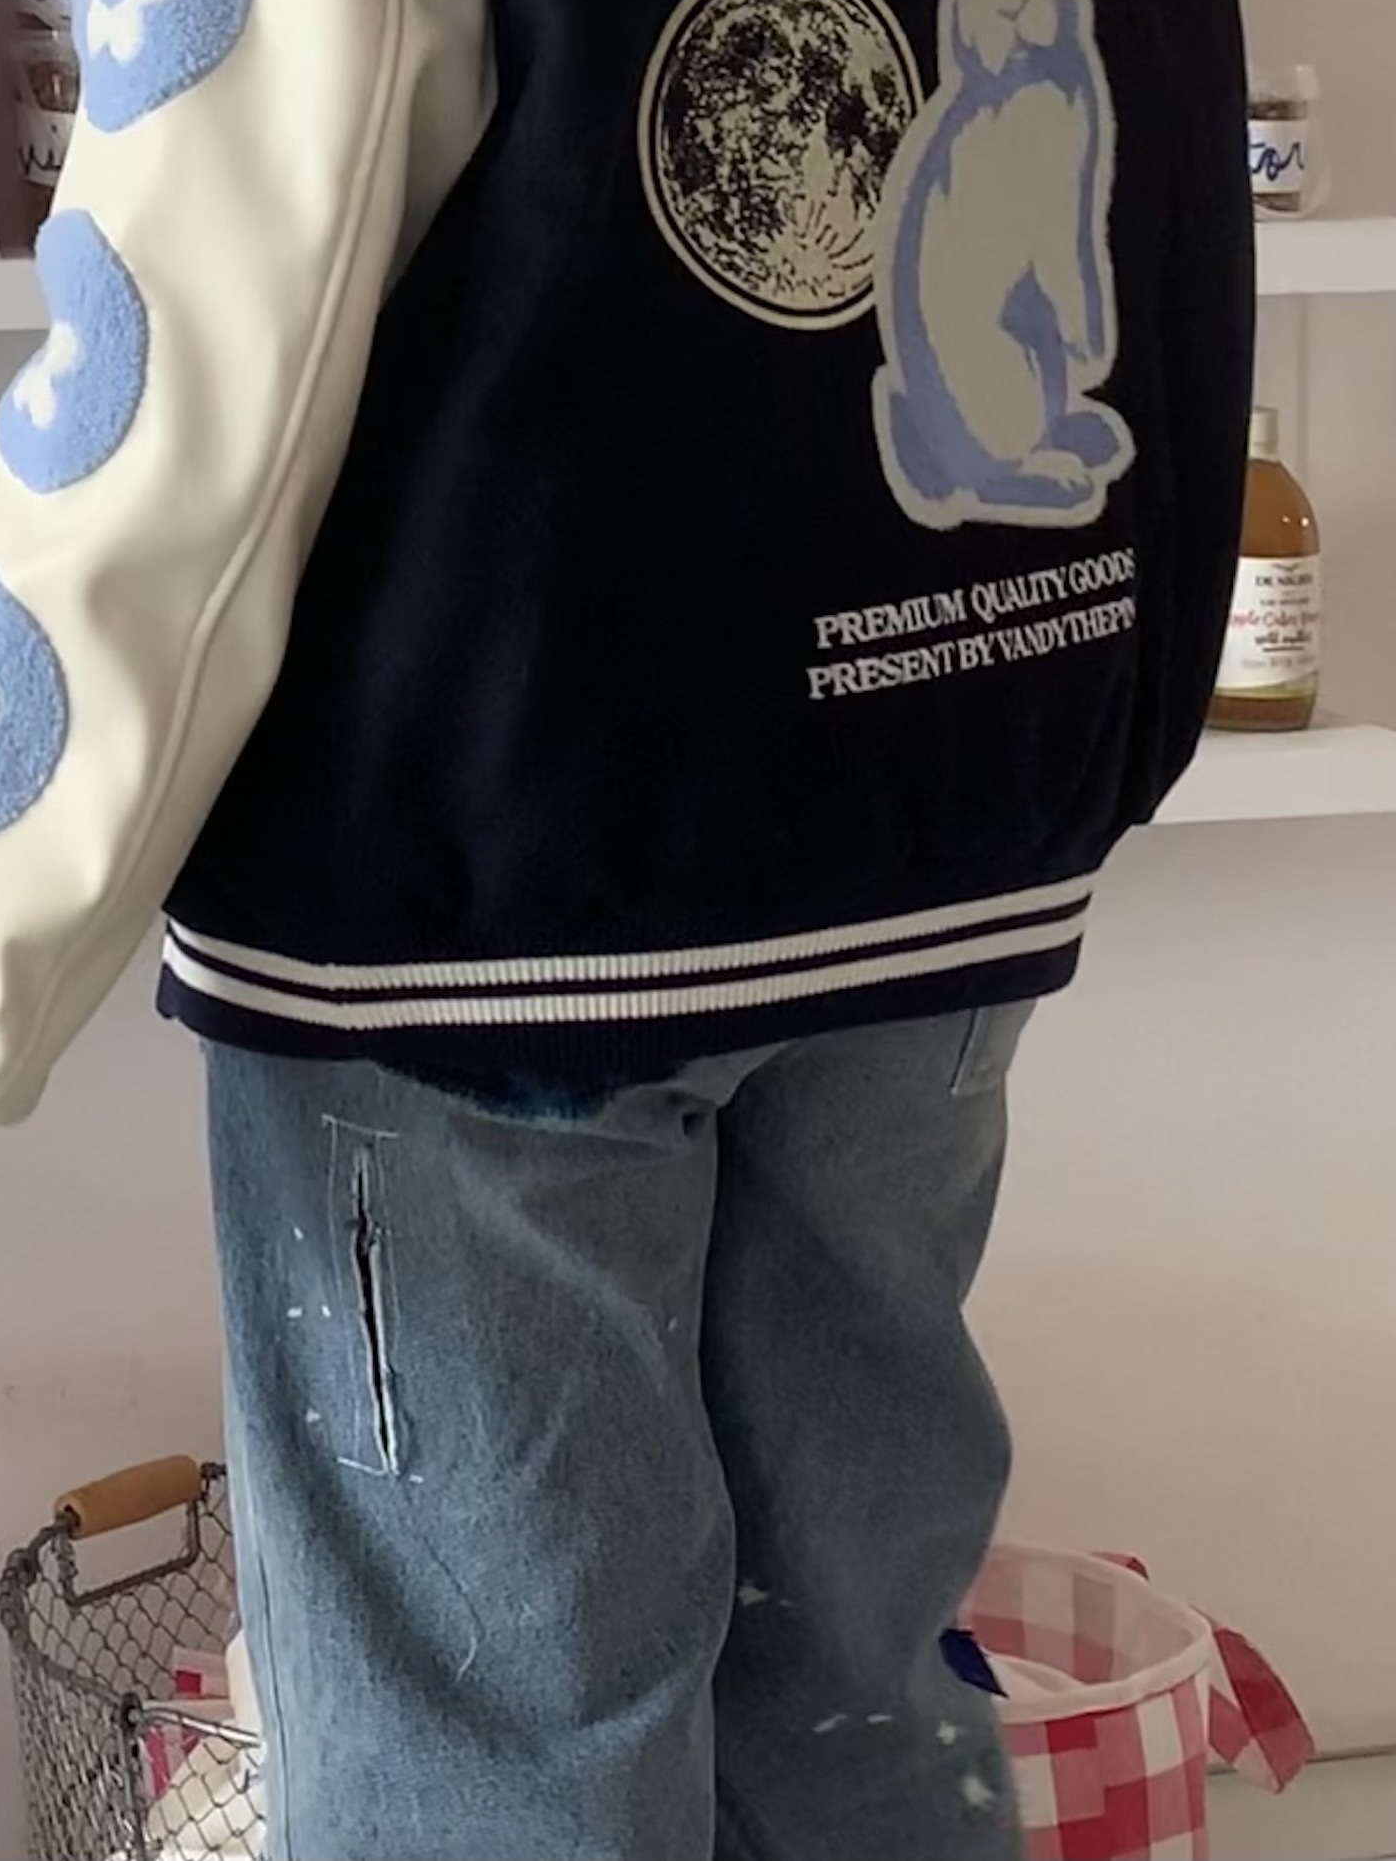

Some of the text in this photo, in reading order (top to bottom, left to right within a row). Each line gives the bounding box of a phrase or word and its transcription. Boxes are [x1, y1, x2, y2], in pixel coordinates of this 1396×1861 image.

[814, 548, 1136, 649] PREMIUM QUALITY GOODS
[806, 641, 955, 700] PRESENT
[957, 632, 997, 671] BY
